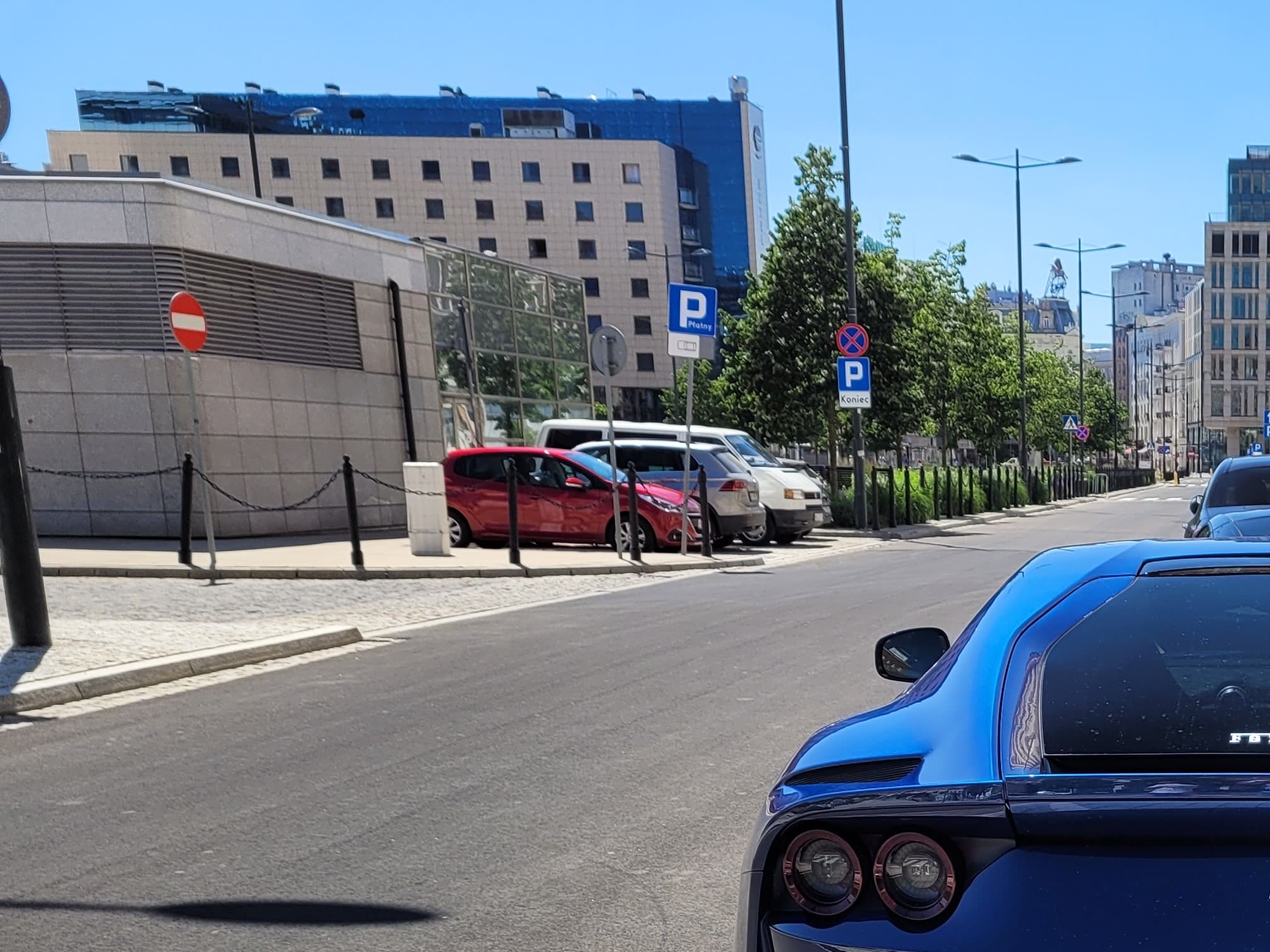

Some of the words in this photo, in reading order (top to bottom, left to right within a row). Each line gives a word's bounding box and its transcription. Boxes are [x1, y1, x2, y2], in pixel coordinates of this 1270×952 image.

[679, 290, 707, 328] P
[845, 361, 863, 387] P
[841, 395, 869, 403] Koniec
